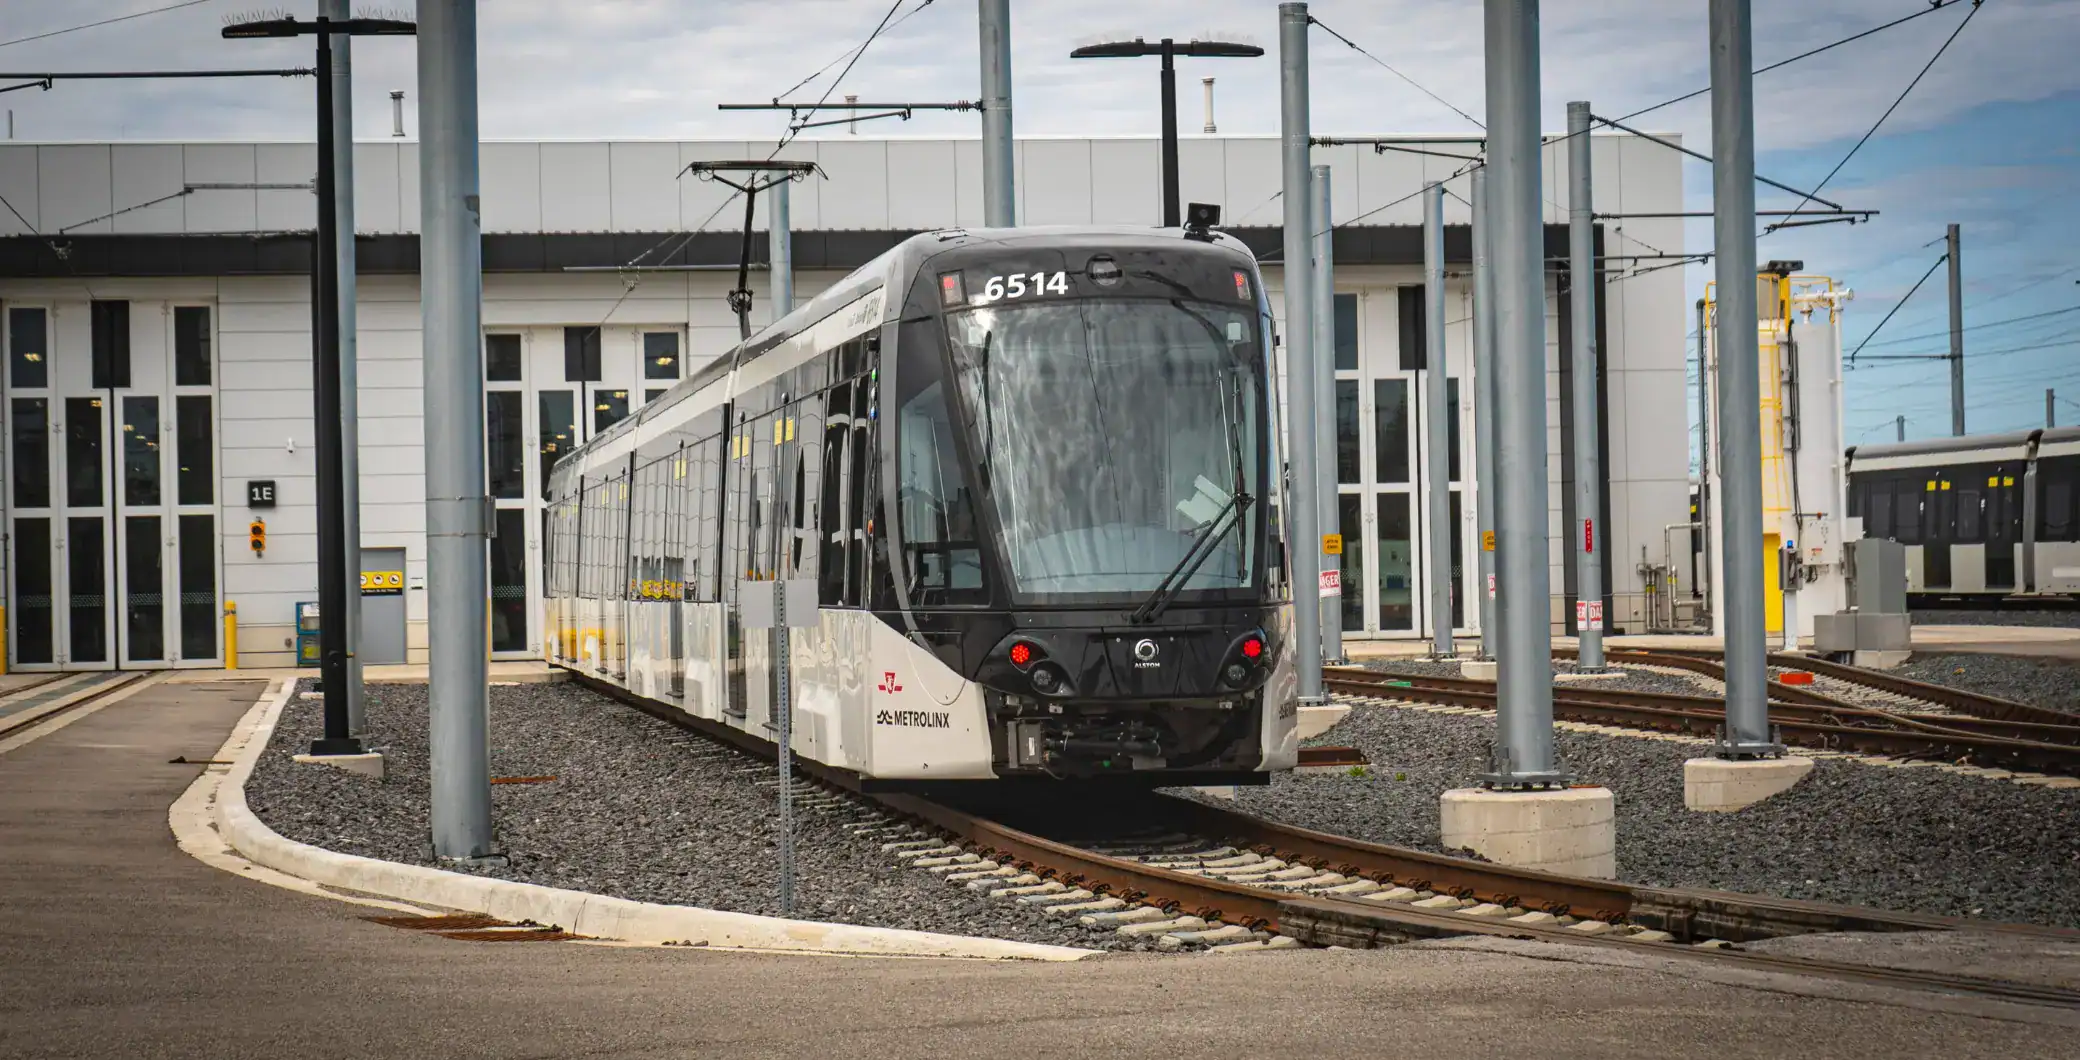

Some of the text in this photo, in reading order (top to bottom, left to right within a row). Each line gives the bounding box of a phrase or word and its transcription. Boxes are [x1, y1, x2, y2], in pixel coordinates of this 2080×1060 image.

[985, 271, 1069, 301] 6514
[252, 486, 273, 501] 1E
[894, 710, 950, 729] METROLINX
